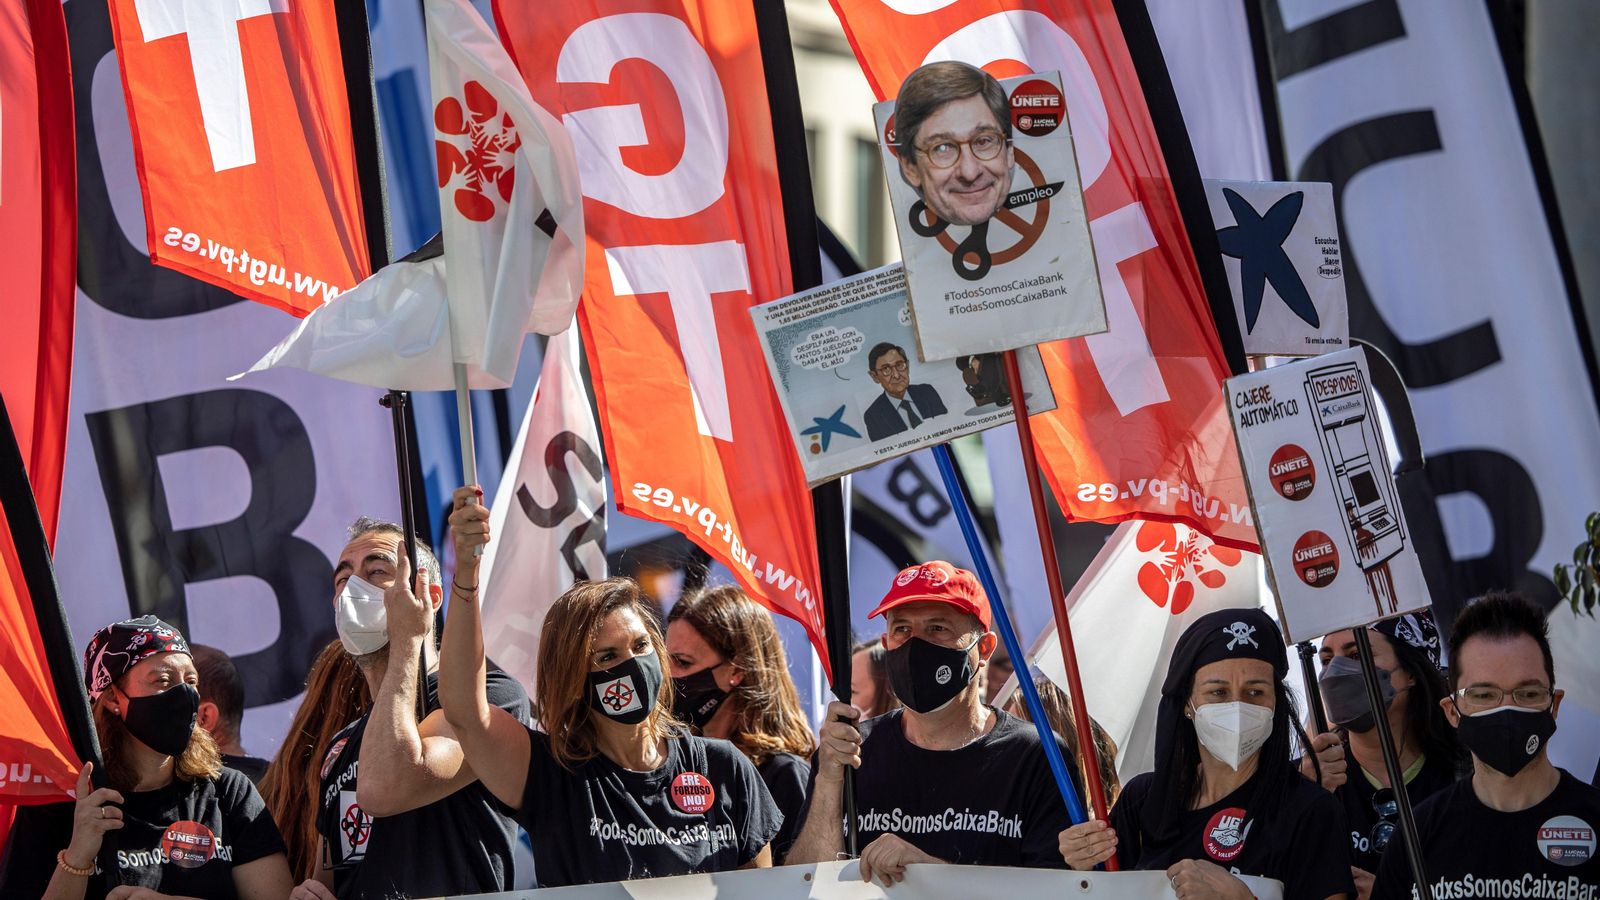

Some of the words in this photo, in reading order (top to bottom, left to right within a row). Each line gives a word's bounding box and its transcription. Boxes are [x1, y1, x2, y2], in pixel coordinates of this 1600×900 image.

[1012, 95, 1059, 107] ÚNETE
[1009, 187, 1054, 205] empleo
[944, 271, 1064, 301] #TodosSomosCaixaBank
[767, 304, 779, 313] SIN
[779, 294, 813, 310] DEVOLVER
[813, 289, 831, 300] NADA
[831, 286, 841, 294] DE
[842, 281, 855, 292] LOS
[771, 311, 784, 320] UNA
[785, 303, 811, 316] SEMANA
[812, 294, 841, 309] DESPUÉS
[842, 292, 851, 301] DE
[852, 286, 866, 297] QUE
[867, 284, 875, 293] EL
[840, 296, 860, 308] CAIXA
[861, 290, 879, 303] BANK
[949, 285, 1068, 315] #TodasSomosCaixaBank
[811, 332, 823, 341] ERA
[824, 328, 835, 338] UN
[842, 330, 856, 340] CON
[794, 349, 821, 361] TANTOS
[822, 342, 851, 356] SUELDOS
[852, 336, 863, 346] NO
[801, 357, 820, 367] DABA
[820, 352, 837, 364] PARA
[837, 345, 858, 359] PAGAR
[1240, 398, 1299, 429] AUTOMÁTICO
[1332, 400, 1361, 413] CaixaBank
[879, 445, 894, 454] ESTA
[923, 433, 932, 441] LA
[932, 427, 952, 438] HEMOS
[953, 421, 977, 432] PAGADO
[977, 414, 998, 425] TODOS
[1271, 456, 1309, 476] ÚNETE
[1295, 543, 1333, 562] ÚNETE
[681, 775, 700, 786] ERE
[674, 785, 711, 795] FORZOSO
[683, 795, 706, 806] ¡NO!
[1218, 815, 1244, 829] UG
[168, 830, 210, 846] ÚNETE
[1542, 829, 1591, 840] ÚNETE
